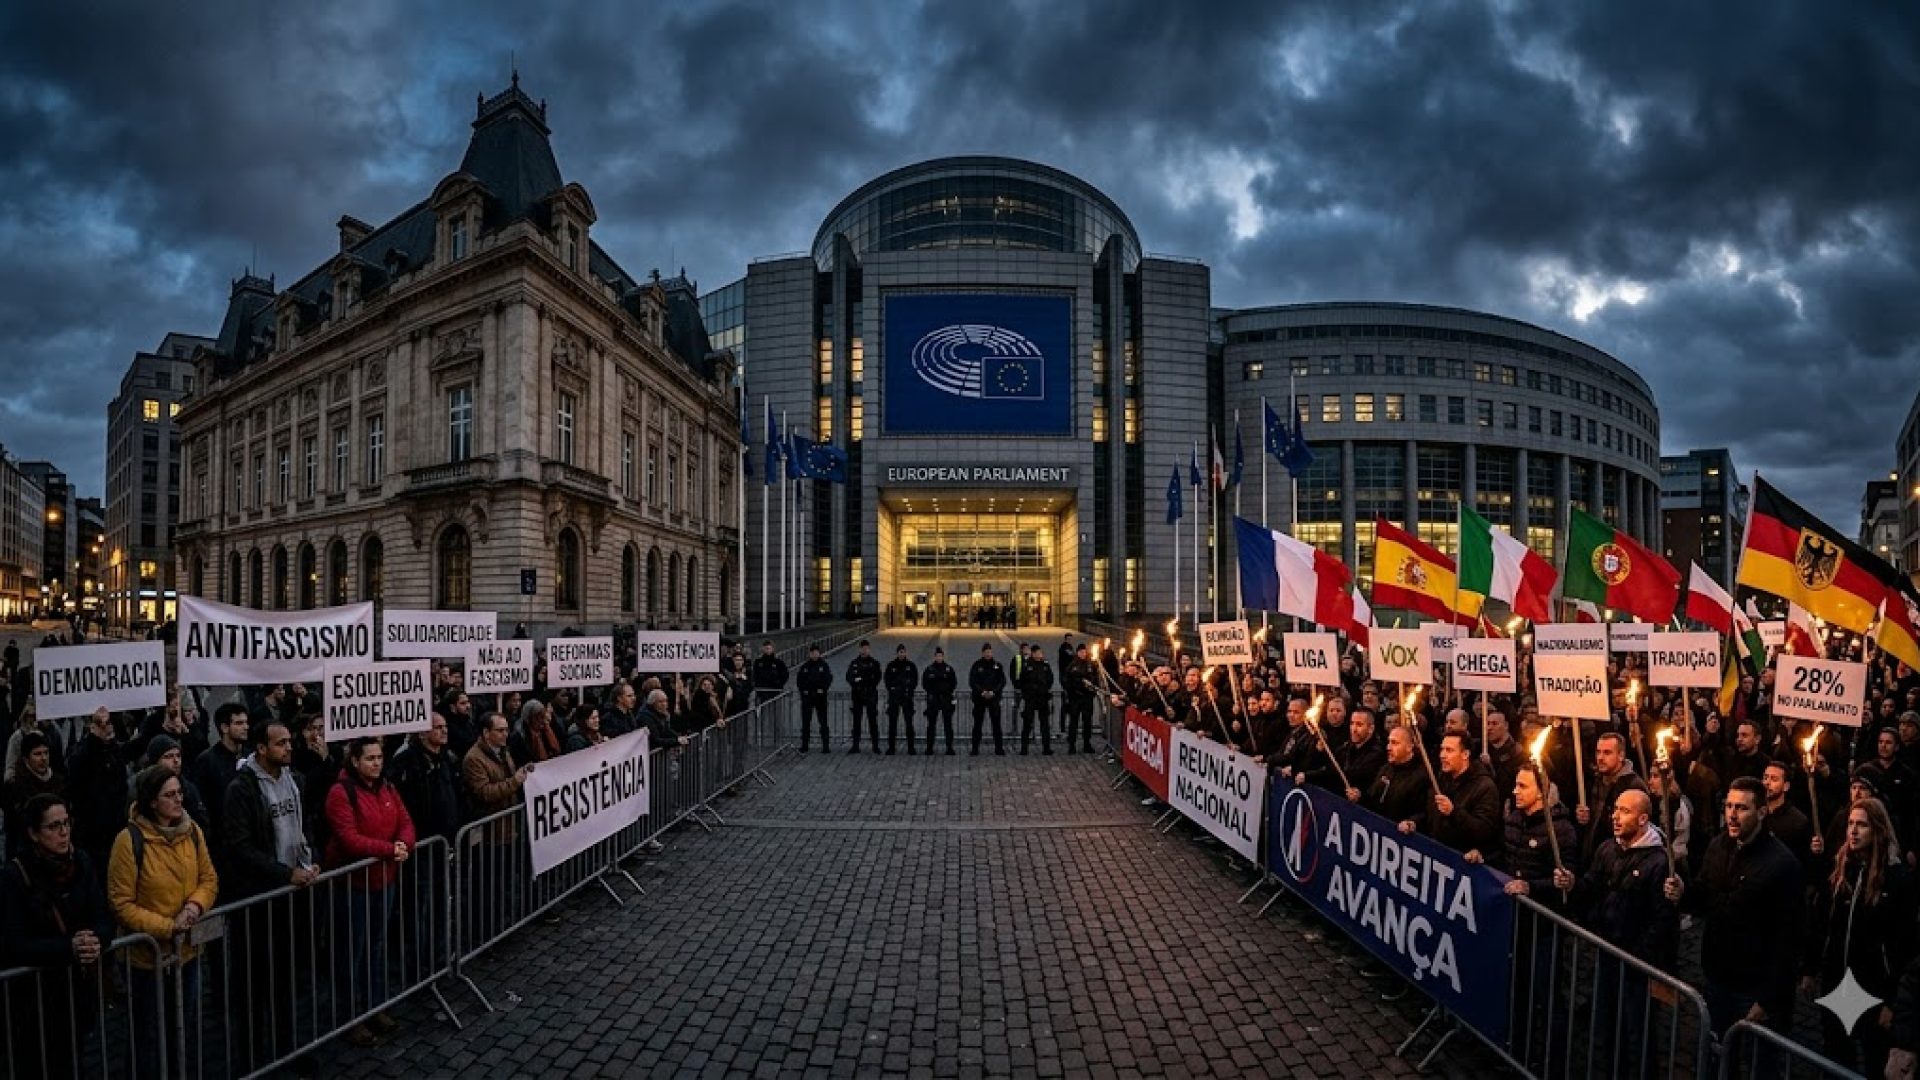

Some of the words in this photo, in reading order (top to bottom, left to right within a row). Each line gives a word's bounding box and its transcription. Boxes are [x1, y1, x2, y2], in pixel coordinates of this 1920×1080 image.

[888, 467, 969, 481] EUROPEAN
[974, 467, 1070, 481] PARLIAMENT
[185, 621, 369, 661] ANTIFASCISMO
[388, 624, 494, 643] SOLIDARIEDADE
[506, 647, 522, 664] AO
[550, 643, 611, 662] REFORMAS
[641, 639, 717, 660] RESISTÊNCIA
[1294, 648, 1328, 670] LIGA
[1380, 641, 1419, 668] VOX
[1651, 648, 1717, 671] TRADIÇÃO
[559, 664, 603, 681] SOCIAIS
[1457, 652, 1511, 673] CHEGA
[39, 660, 162, 697] DEMOCRACIA
[333, 671, 424, 700] ESQUERDA
[470, 667, 530, 688] FASCISMO
[1538, 676, 1602, 698] TRADIÇÃO
[1793, 666, 1845, 698] 28%
[330, 698, 427, 731] MODERADA
[1777, 694, 1791, 707] NO
[1793, 696, 1858, 716] PARLAMENTO
[1126, 720, 1165, 775] CHEGA
[1179, 742, 1251, 801] REUNIÃO
[533, 754, 645, 841] RESISTÊNCIA
[1175, 774, 1253, 842] NACIONAL
[1324, 811, 1344, 855] A
[1349, 821, 1477, 934] DIREITA
[1326, 864, 1462, 994] AVANÇA
